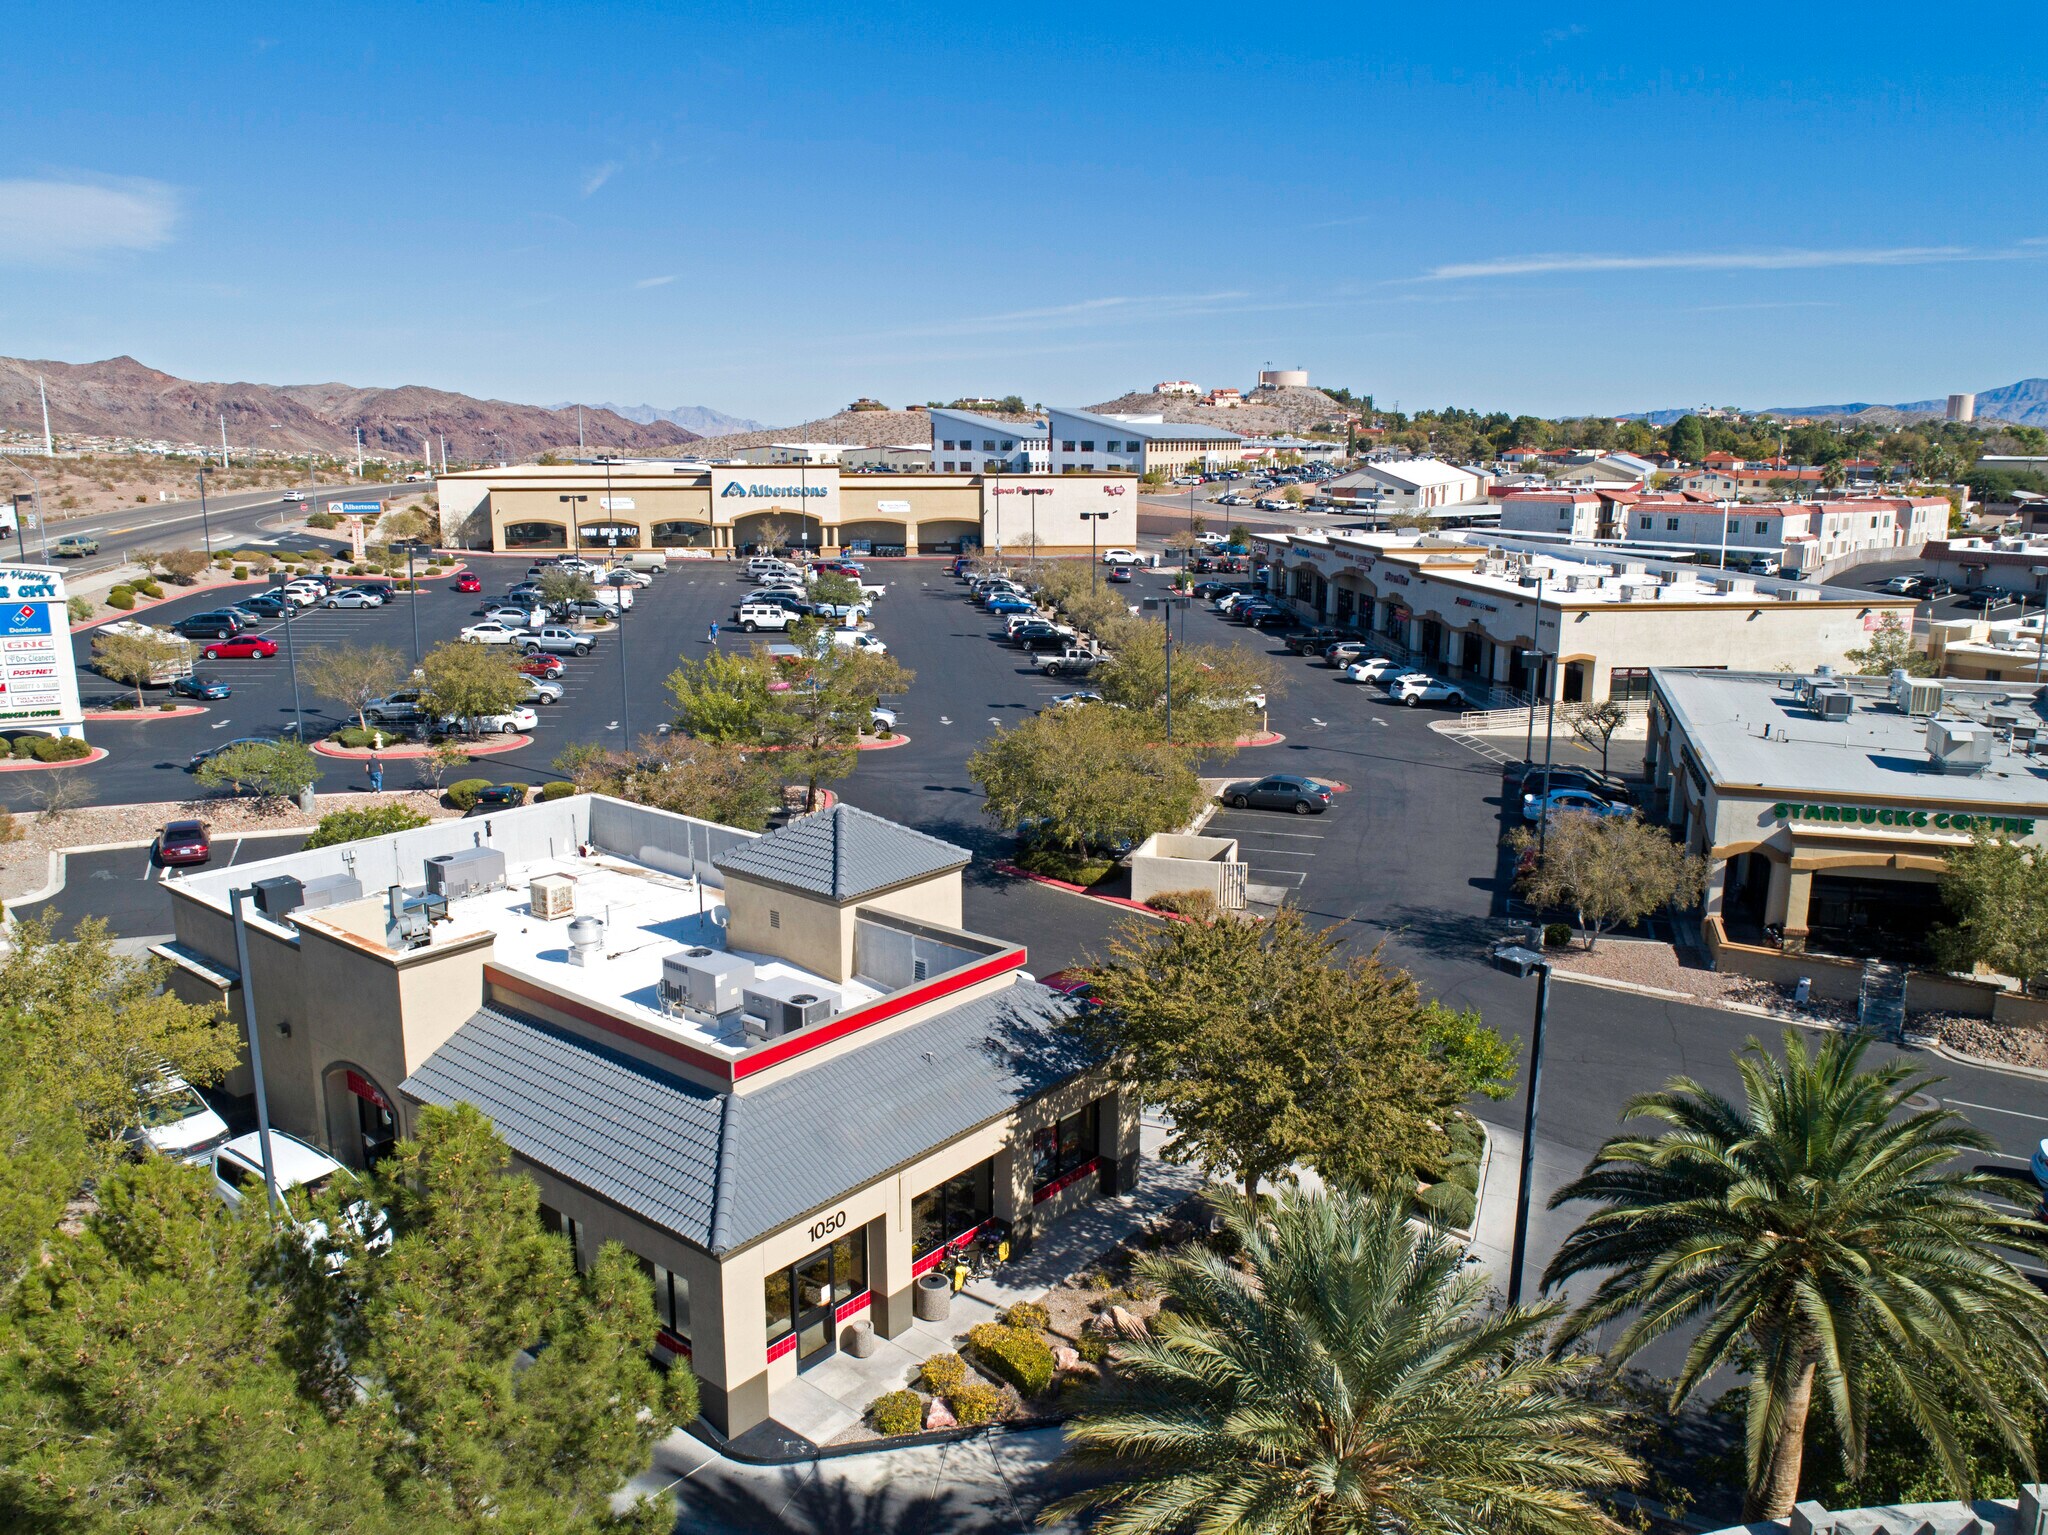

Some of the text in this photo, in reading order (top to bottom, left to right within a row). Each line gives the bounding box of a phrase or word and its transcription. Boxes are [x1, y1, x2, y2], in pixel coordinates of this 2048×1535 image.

[748, 484, 828, 498] Albertsons
[1016, 486, 1055, 496] Phrmcy
[580, 528, 638, 536] NOW OPN 24/7
[18, 584, 57, 598] CITY
[7, 640, 52, 649] GNC
[29, 654, 55, 662] Cleaners
[1774, 803, 2036, 835] STARBUCKS COFFEE
[807, 1210, 847, 1242] 1050
